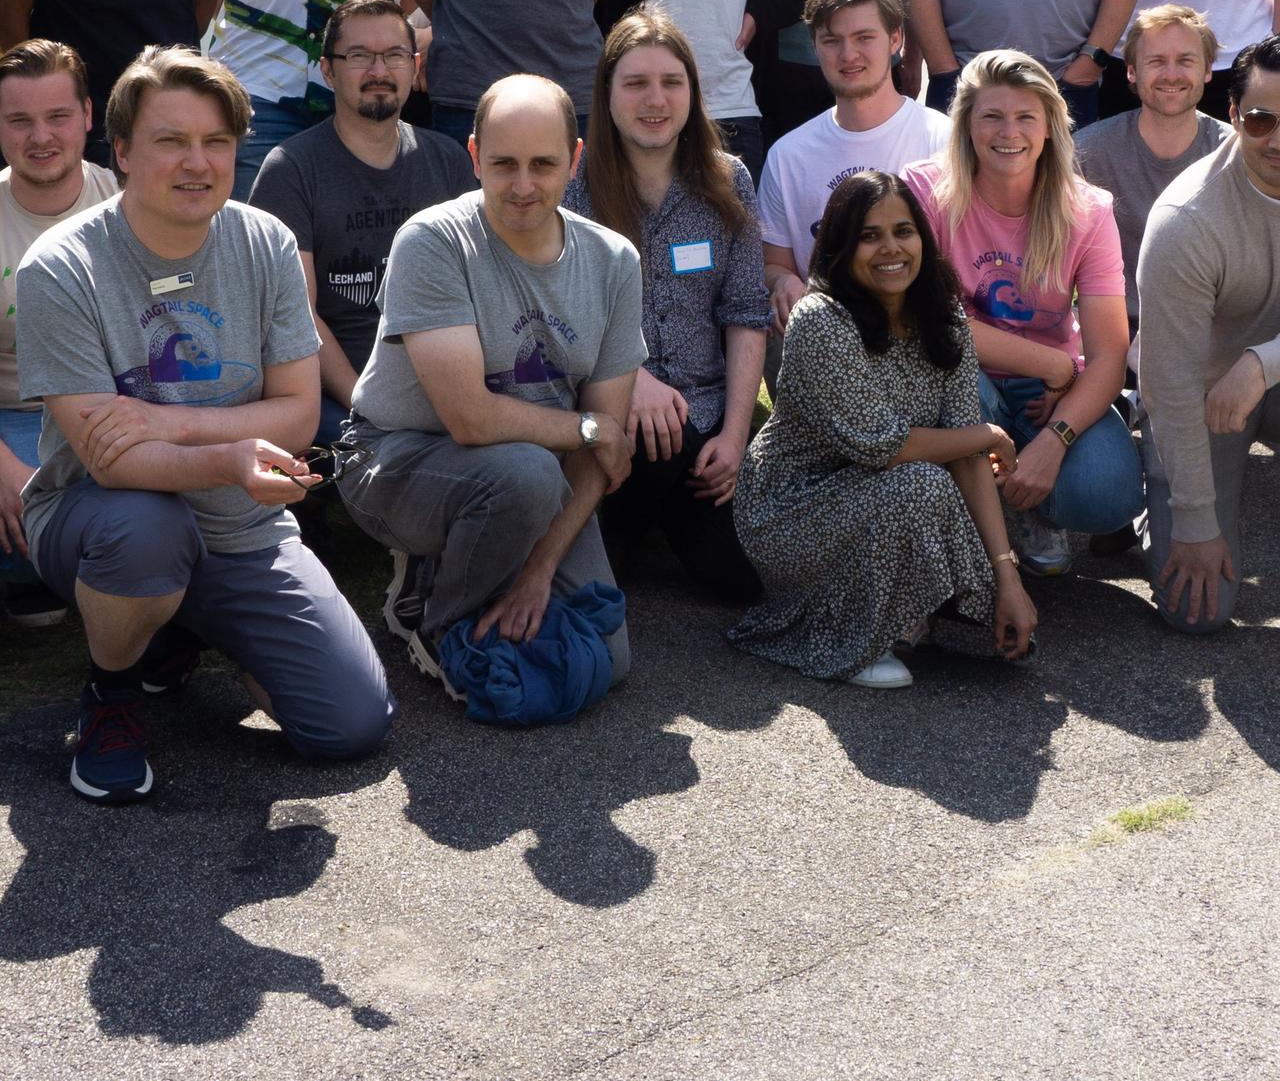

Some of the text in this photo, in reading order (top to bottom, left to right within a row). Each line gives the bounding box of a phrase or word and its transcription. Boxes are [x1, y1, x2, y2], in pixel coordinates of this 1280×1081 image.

[186, 300, 226, 329] SPACE
[512, 309, 578, 345] WAAIL SPACE
